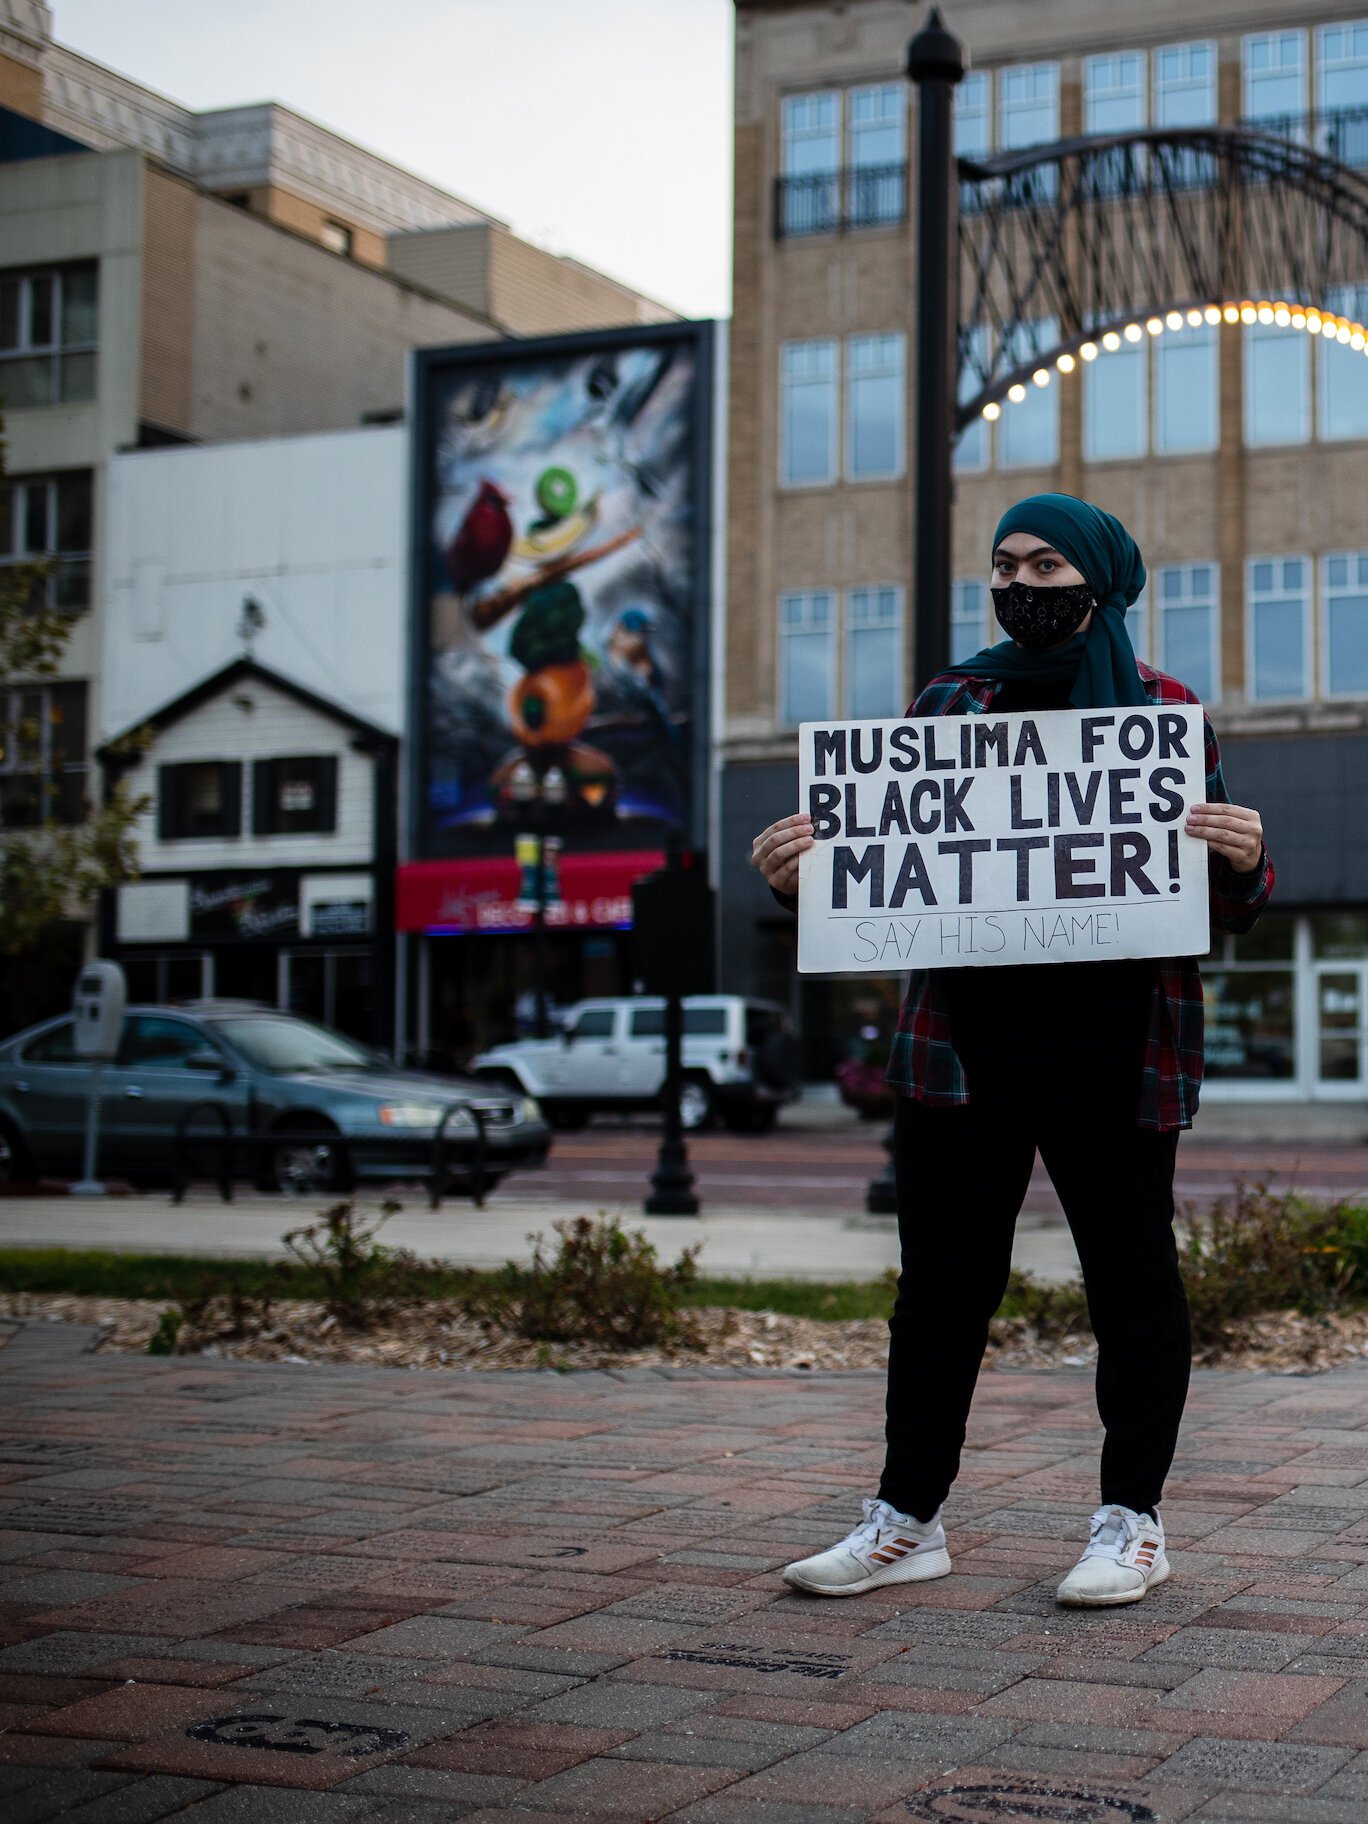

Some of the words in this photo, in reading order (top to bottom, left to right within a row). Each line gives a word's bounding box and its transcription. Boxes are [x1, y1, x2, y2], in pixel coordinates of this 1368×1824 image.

[813, 719, 1048, 777] MUSLIMA
[1081, 713, 1191, 764] FOR
[809, 776, 975, 840] BLACK
[1009, 766, 1187, 831] LIVES
[831, 829, 1182, 910] MATTER!
[853, 918, 921, 963] SAY
[939, 916, 1006, 956] HIS
[1022, 912, 1122, 953] NAME!
